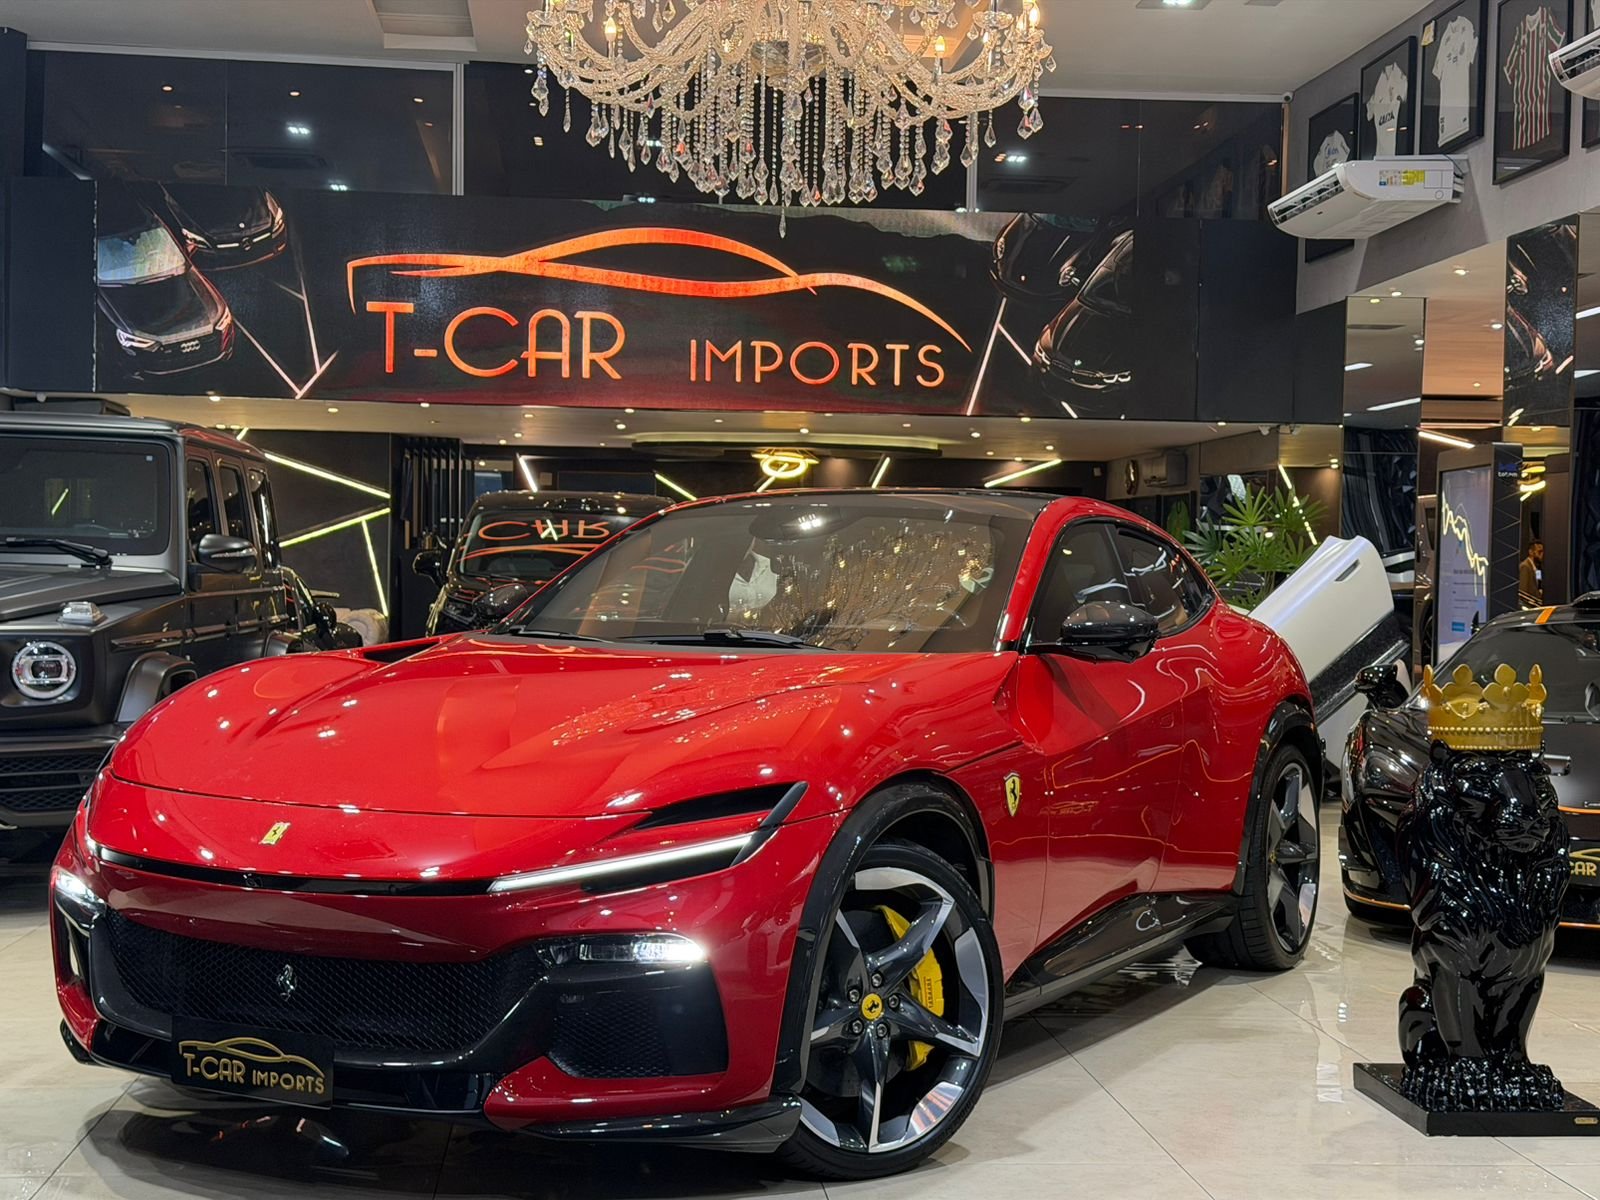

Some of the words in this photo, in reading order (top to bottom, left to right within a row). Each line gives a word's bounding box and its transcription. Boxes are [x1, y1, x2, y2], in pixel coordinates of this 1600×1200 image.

[365, 301, 626, 380] T-CAR
[689, 338, 946, 388] IMPORTS
[183, 1053, 246, 1084] T-CAR
[252, 1069, 325, 1095] IMPORTS
